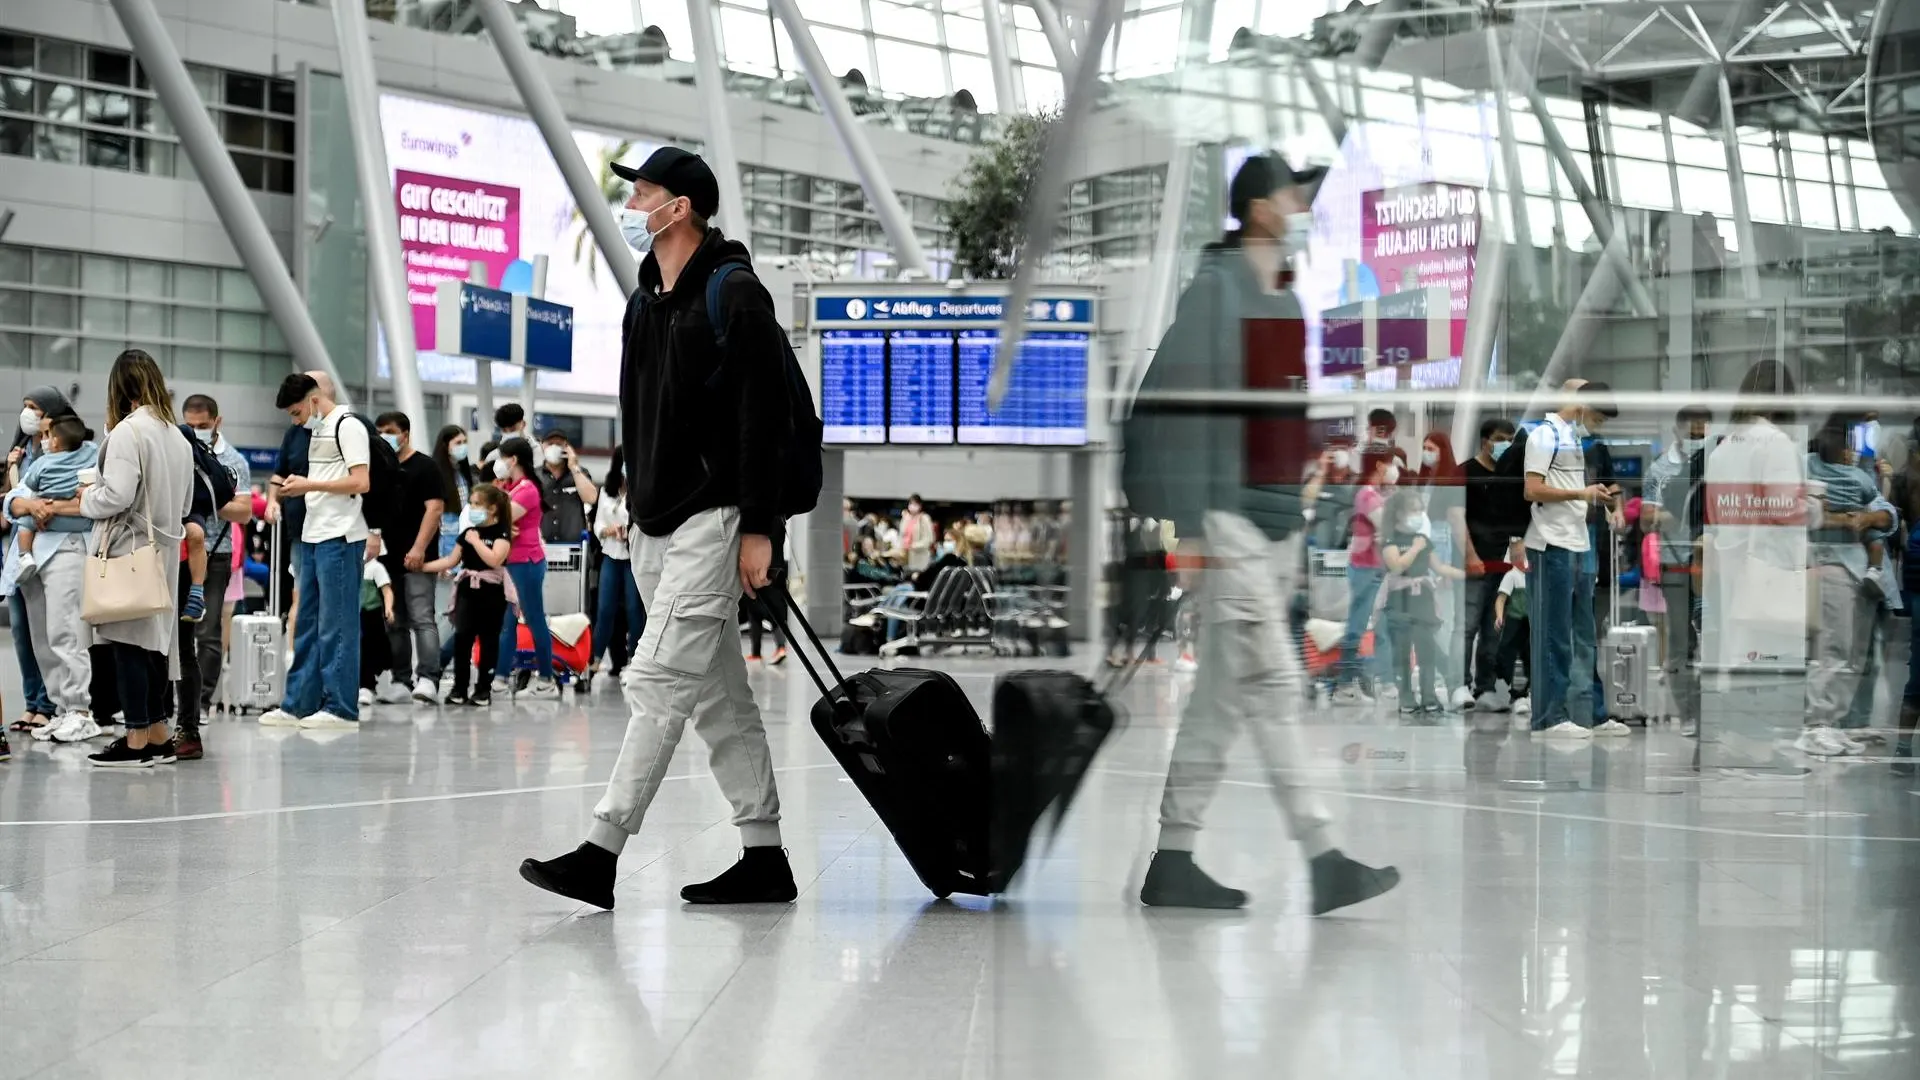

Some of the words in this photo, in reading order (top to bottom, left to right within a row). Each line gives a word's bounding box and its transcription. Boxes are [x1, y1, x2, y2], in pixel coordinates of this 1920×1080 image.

[401, 131, 459, 158] Eurowings
[400, 183, 430, 211] GUT
[430, 188, 508, 222] GESCHÜTZT
[400, 216, 417, 241] IN
[418, 218, 449, 246] DEN
[450, 222, 508, 253] URLAUB.
[891, 301, 932, 318] Abflug
[938, 301, 1002, 317] Departures
[1717, 493, 1741, 507] Mit
[1746, 493, 1795, 508] Termin
